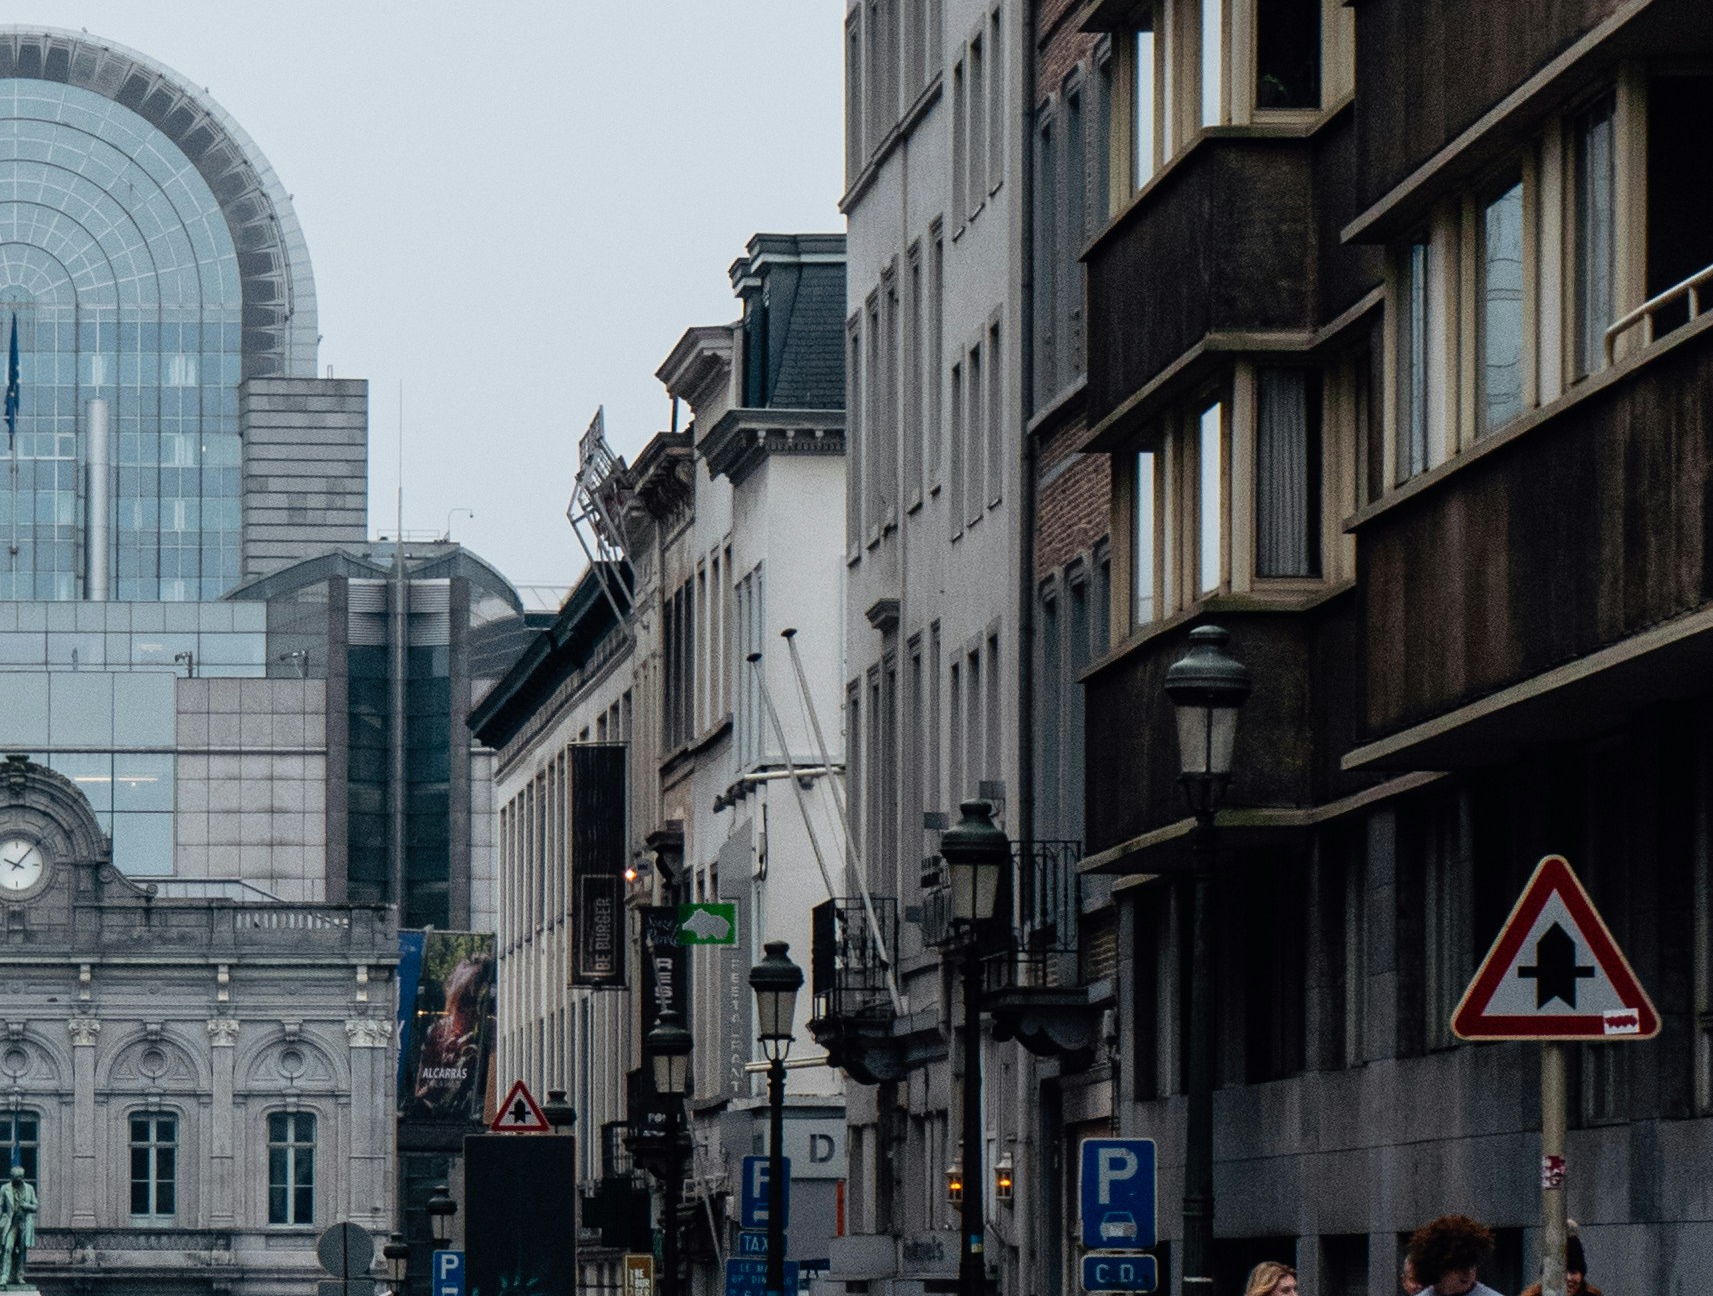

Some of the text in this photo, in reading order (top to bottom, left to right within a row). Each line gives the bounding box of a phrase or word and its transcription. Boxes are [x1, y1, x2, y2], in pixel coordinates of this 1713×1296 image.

[593, 897, 612, 971] BE BURGER
[809, 1135, 835, 1162] D
[1098, 1148, 1139, 1204] P
[743, 1236, 769, 1252] TAX
[441, 1253, 460, 1280] P
